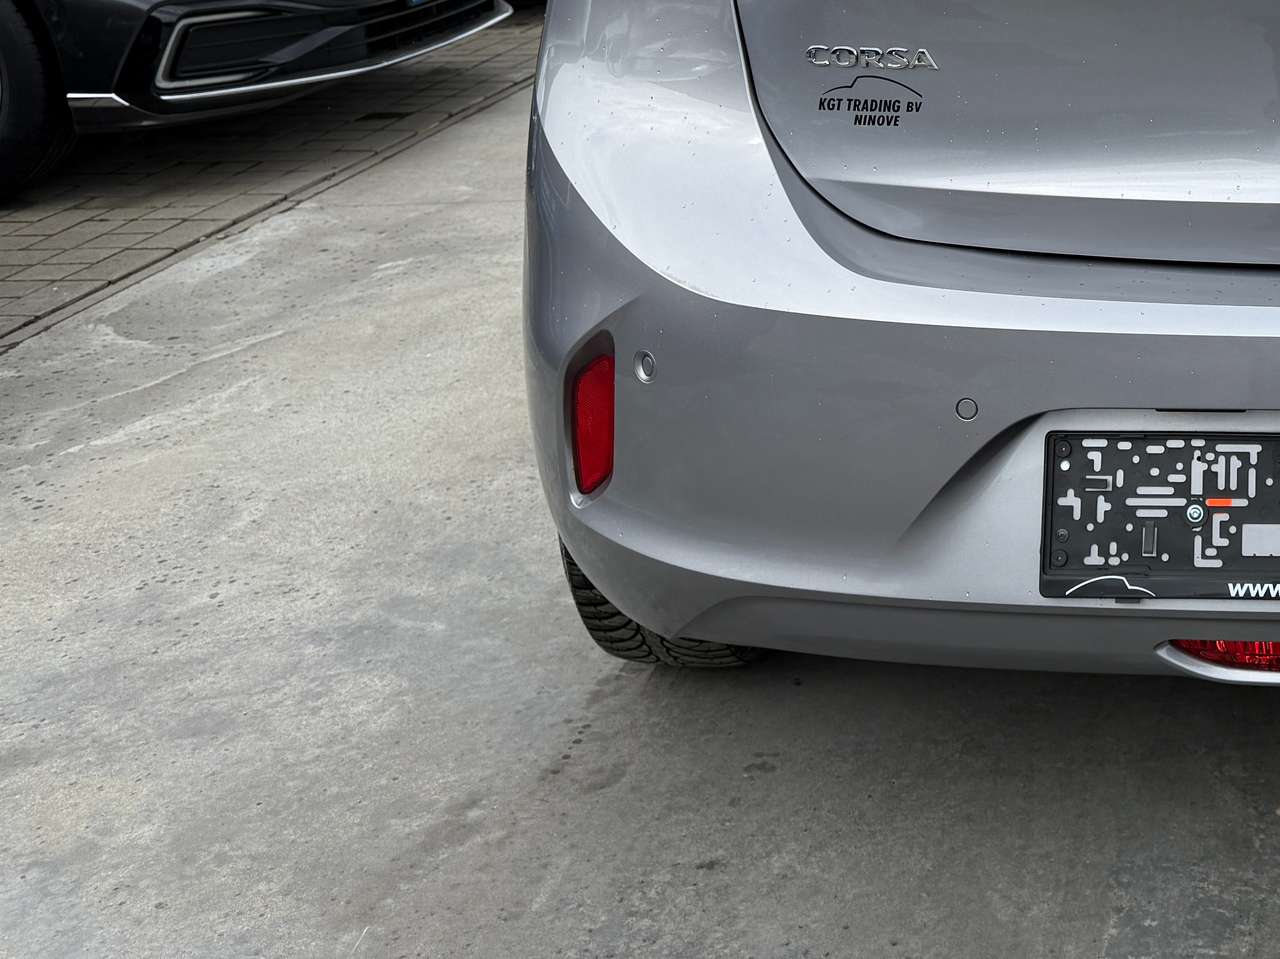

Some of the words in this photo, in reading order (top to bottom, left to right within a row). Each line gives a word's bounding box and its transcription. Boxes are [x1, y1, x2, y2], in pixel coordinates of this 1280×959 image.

[806, 44, 939, 70] CORSA
[818, 97, 843, 111] KGT
[847, 98, 901, 112] TRADING
[906, 101, 923, 113] BV
[854, 114, 900, 127] NINOVE
